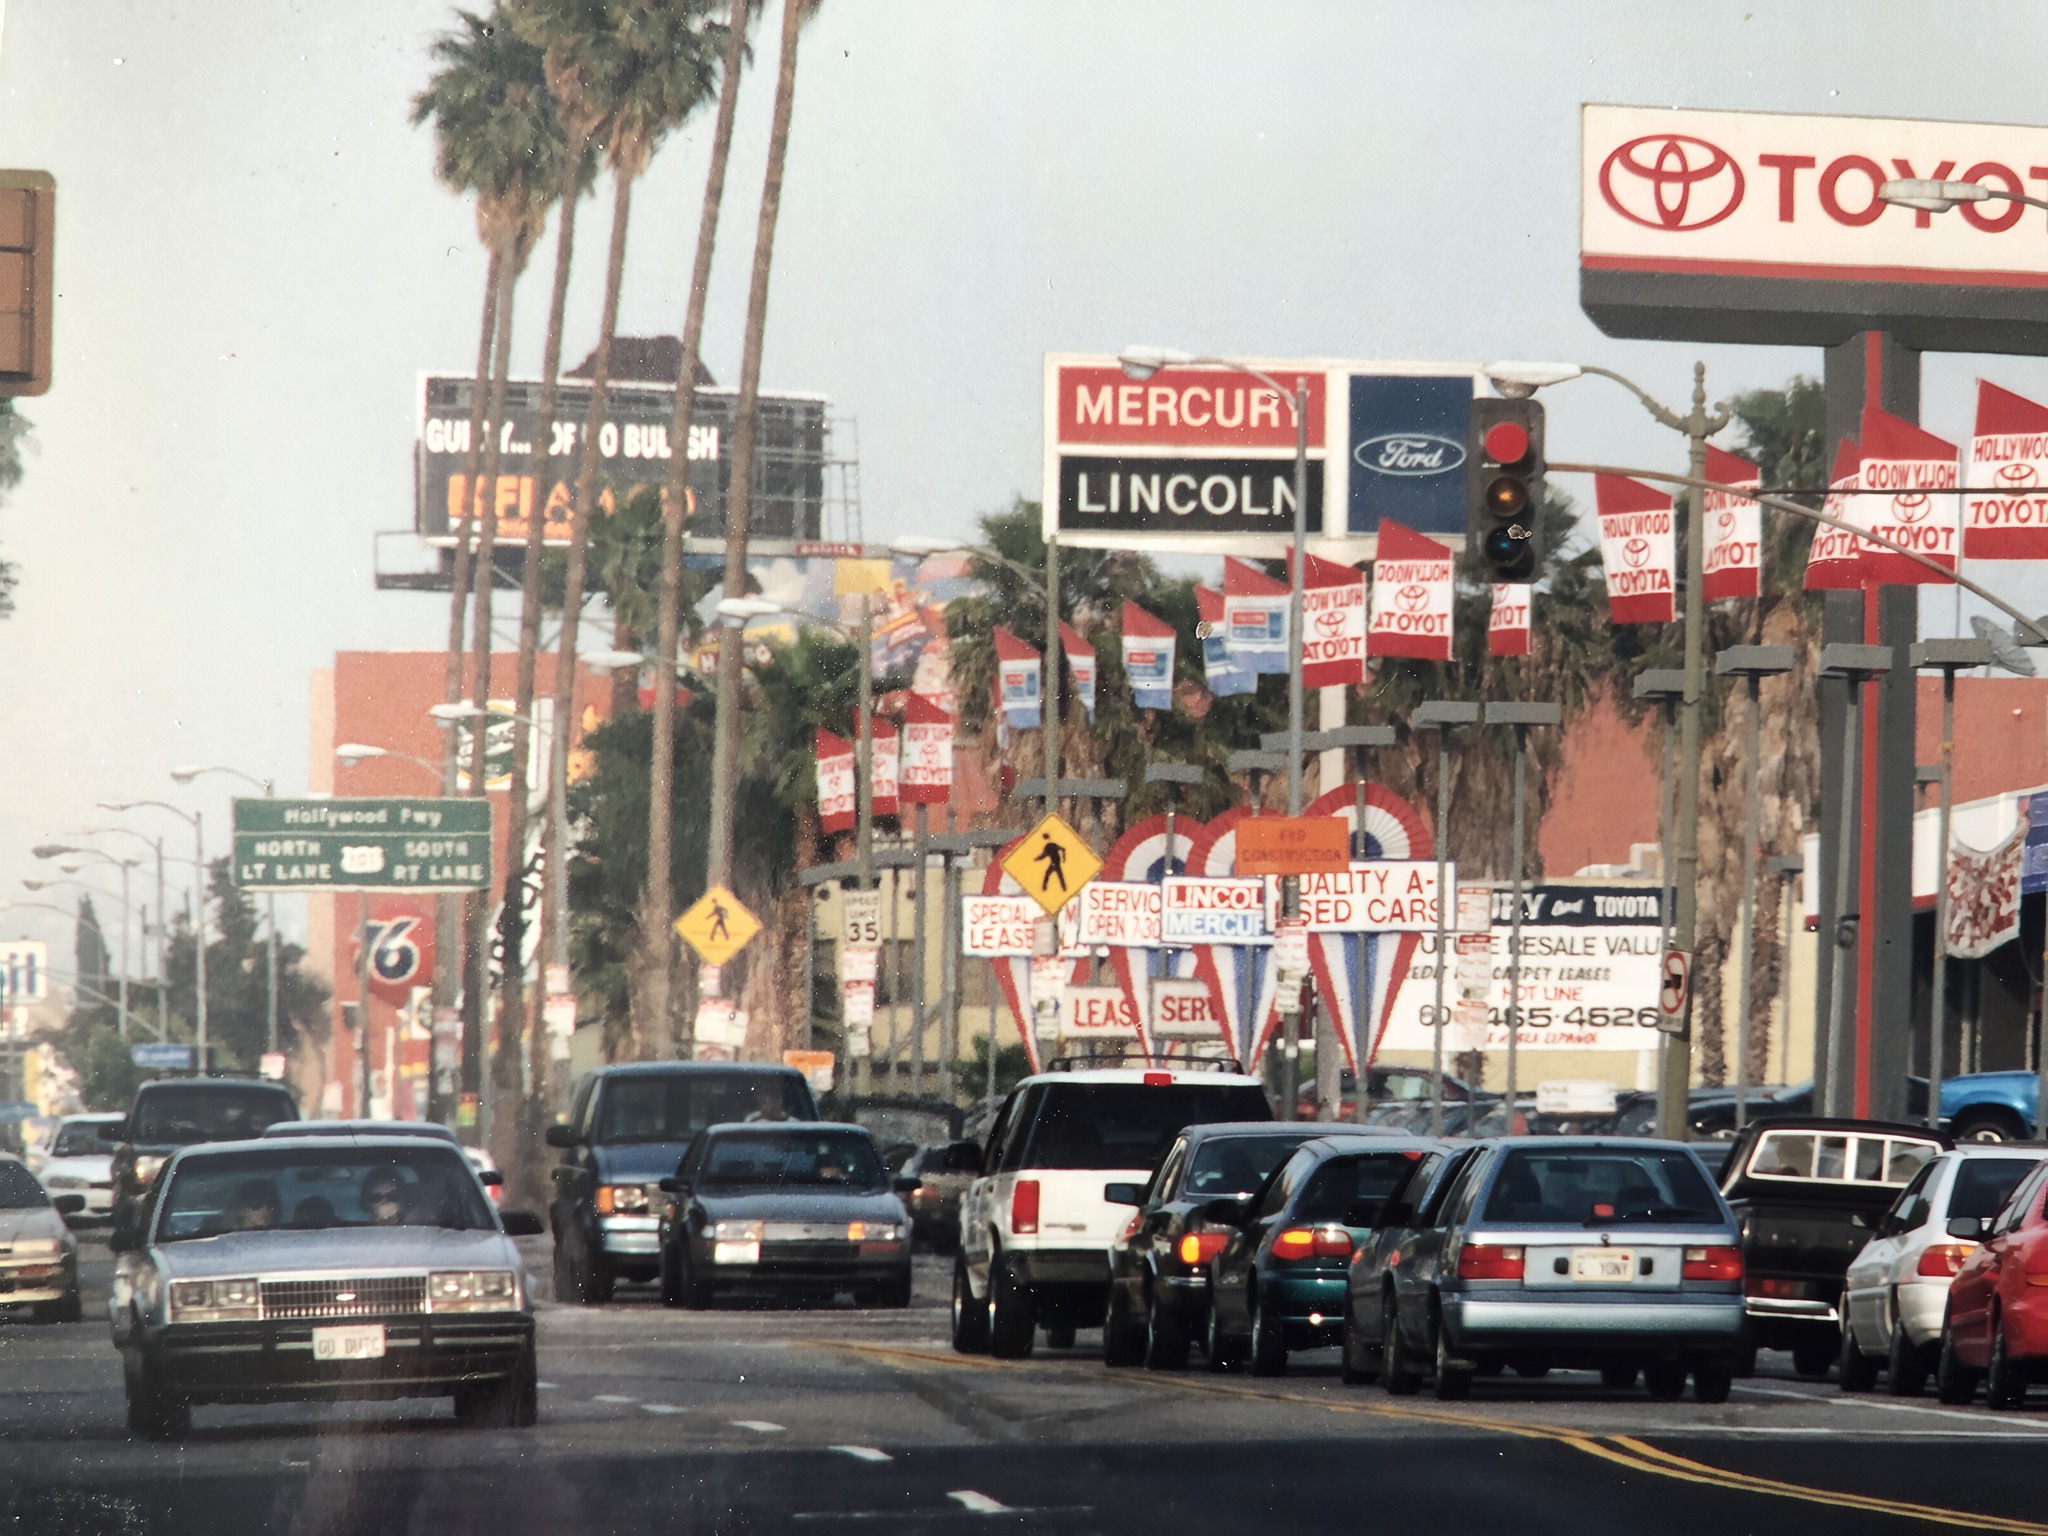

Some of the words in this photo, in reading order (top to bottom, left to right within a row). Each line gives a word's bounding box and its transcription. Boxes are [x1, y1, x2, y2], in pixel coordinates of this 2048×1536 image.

[1377, 438, 1444, 470] Ford
[1078, 472, 1298, 516] LINCOLN
[1603, 513, 1670, 539] HOLLYWOOD
[1610, 569, 1671, 593] TOYOTA
[284, 808, 388, 828] Hollywood
[255, 840, 321, 856] NORTH
[405, 841, 469, 857] SOUTH
[242, 864, 266, 880] LT
[276, 864, 331, 880] LANE
[393, 865, 420, 881] RT
[429, 865, 483, 881] LANE
[1275, 870, 1389, 895] UALITY
[970, 904, 1030, 925] SPECIAL
[1275, 898, 1352, 923] SED
[1593, 896, 1660, 918] TOYOTA
[849, 922, 878, 941] 35
[1088, 915, 1125, 938] OPEN
[1493, 966, 1553, 981] CAPET
[1544, 986, 1584, 1001] LINE
